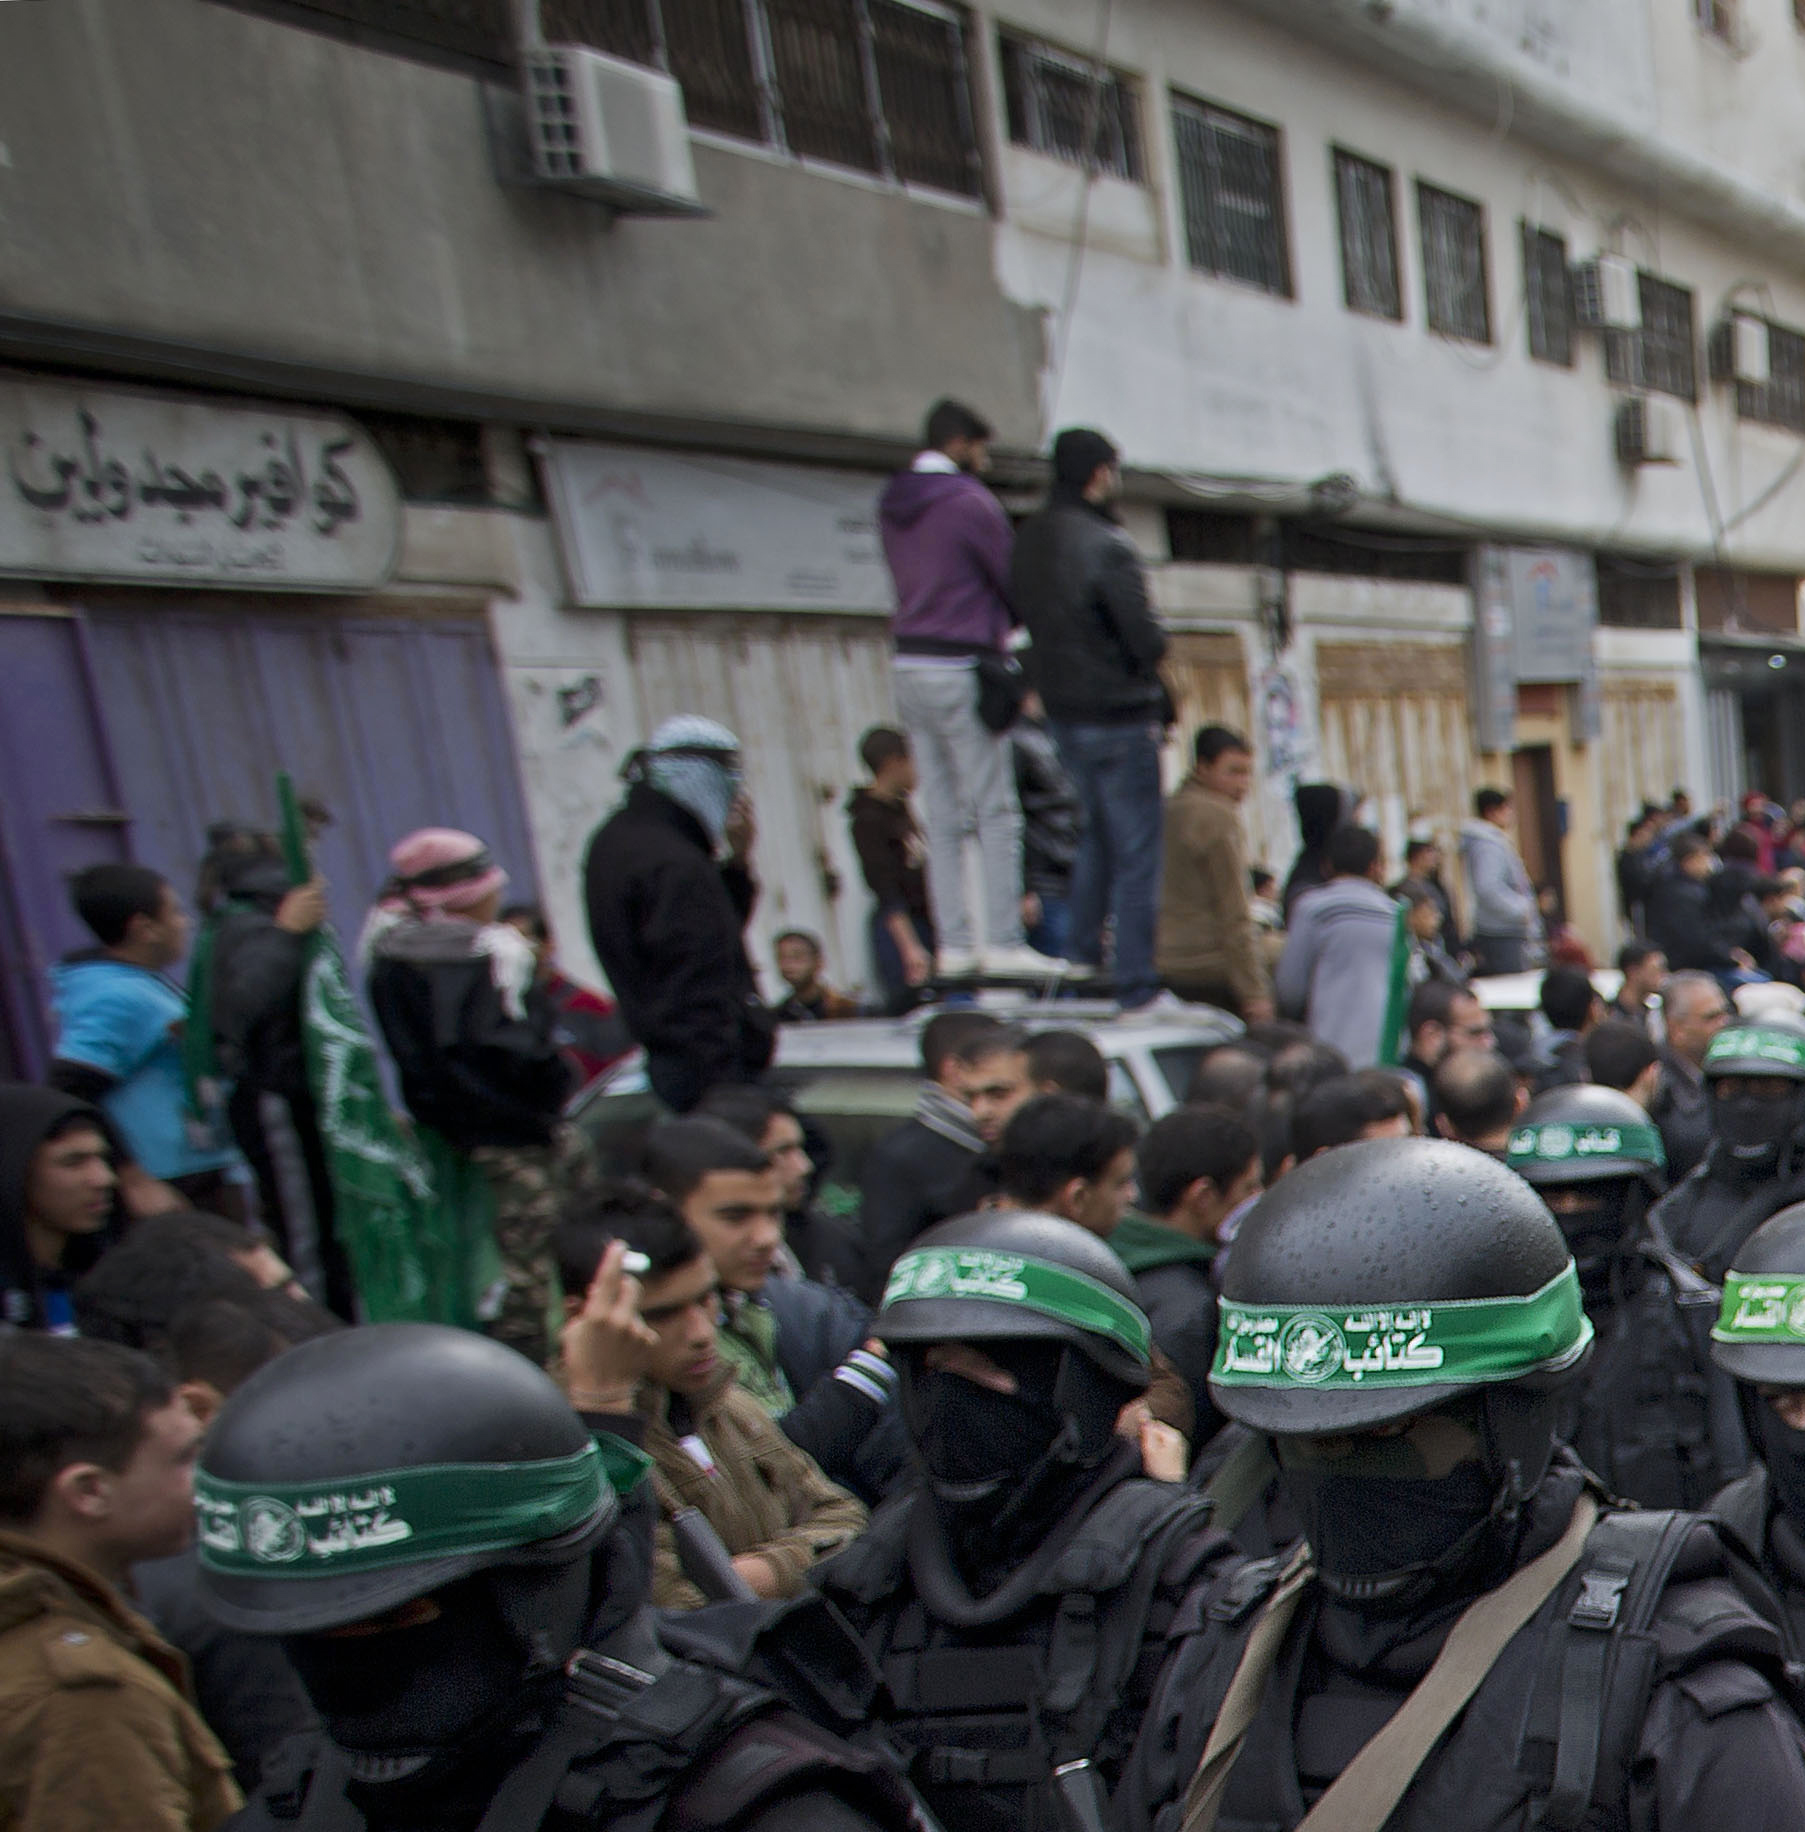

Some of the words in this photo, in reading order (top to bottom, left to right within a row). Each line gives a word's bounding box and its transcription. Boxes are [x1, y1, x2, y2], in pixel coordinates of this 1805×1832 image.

[229, 422, 360, 538] كوافير
[1343, 1331, 1444, 1382] كتائب
[307, 1512, 413, 1559] كتائب
